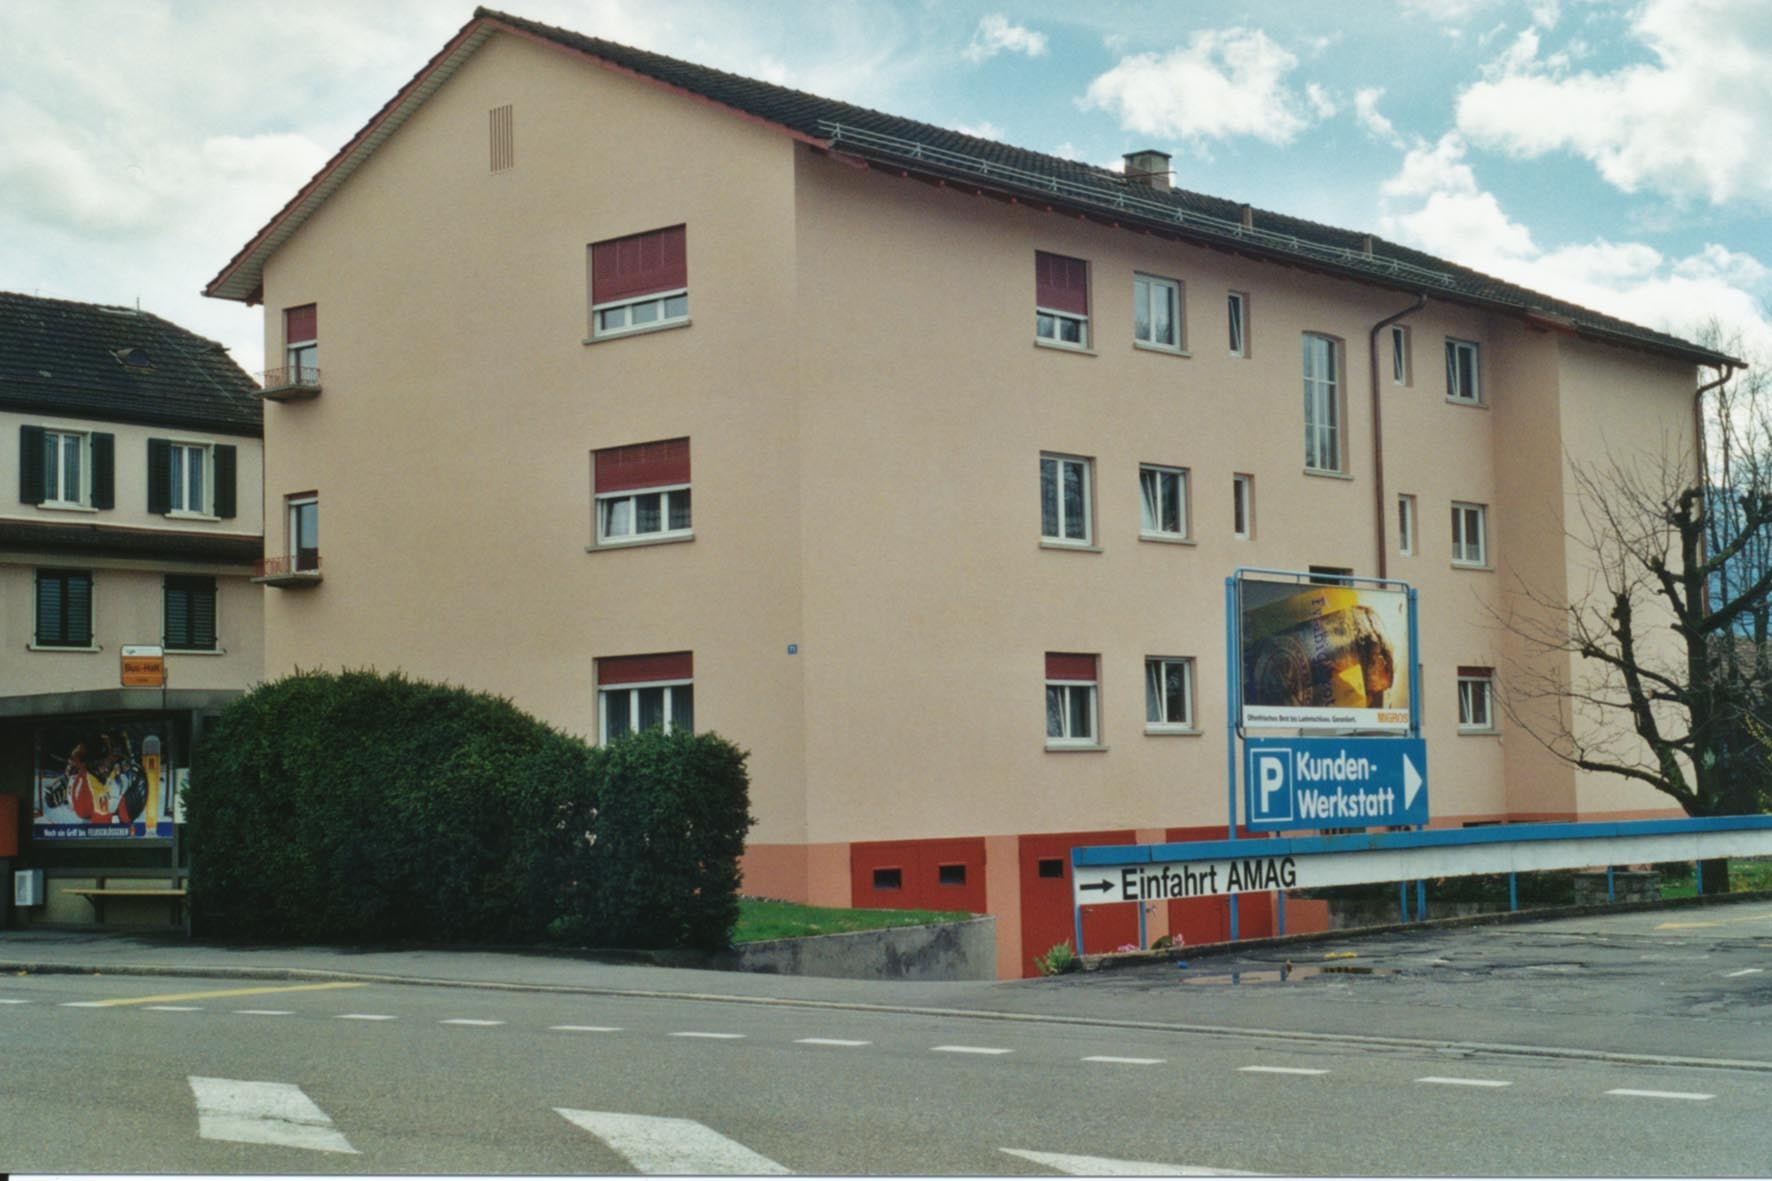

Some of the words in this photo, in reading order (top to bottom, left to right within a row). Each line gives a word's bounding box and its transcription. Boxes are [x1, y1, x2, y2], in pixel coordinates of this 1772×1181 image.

[1377, 712, 1408, 723] MIGROS
[1296, 750, 1377, 781] Kunden-
[1260, 756, 1284, 813] P
[1297, 787, 1395, 820] Werkstatt
[1121, 864, 1218, 900] Einfahrt
[1227, 857, 1296, 891] AMAG
